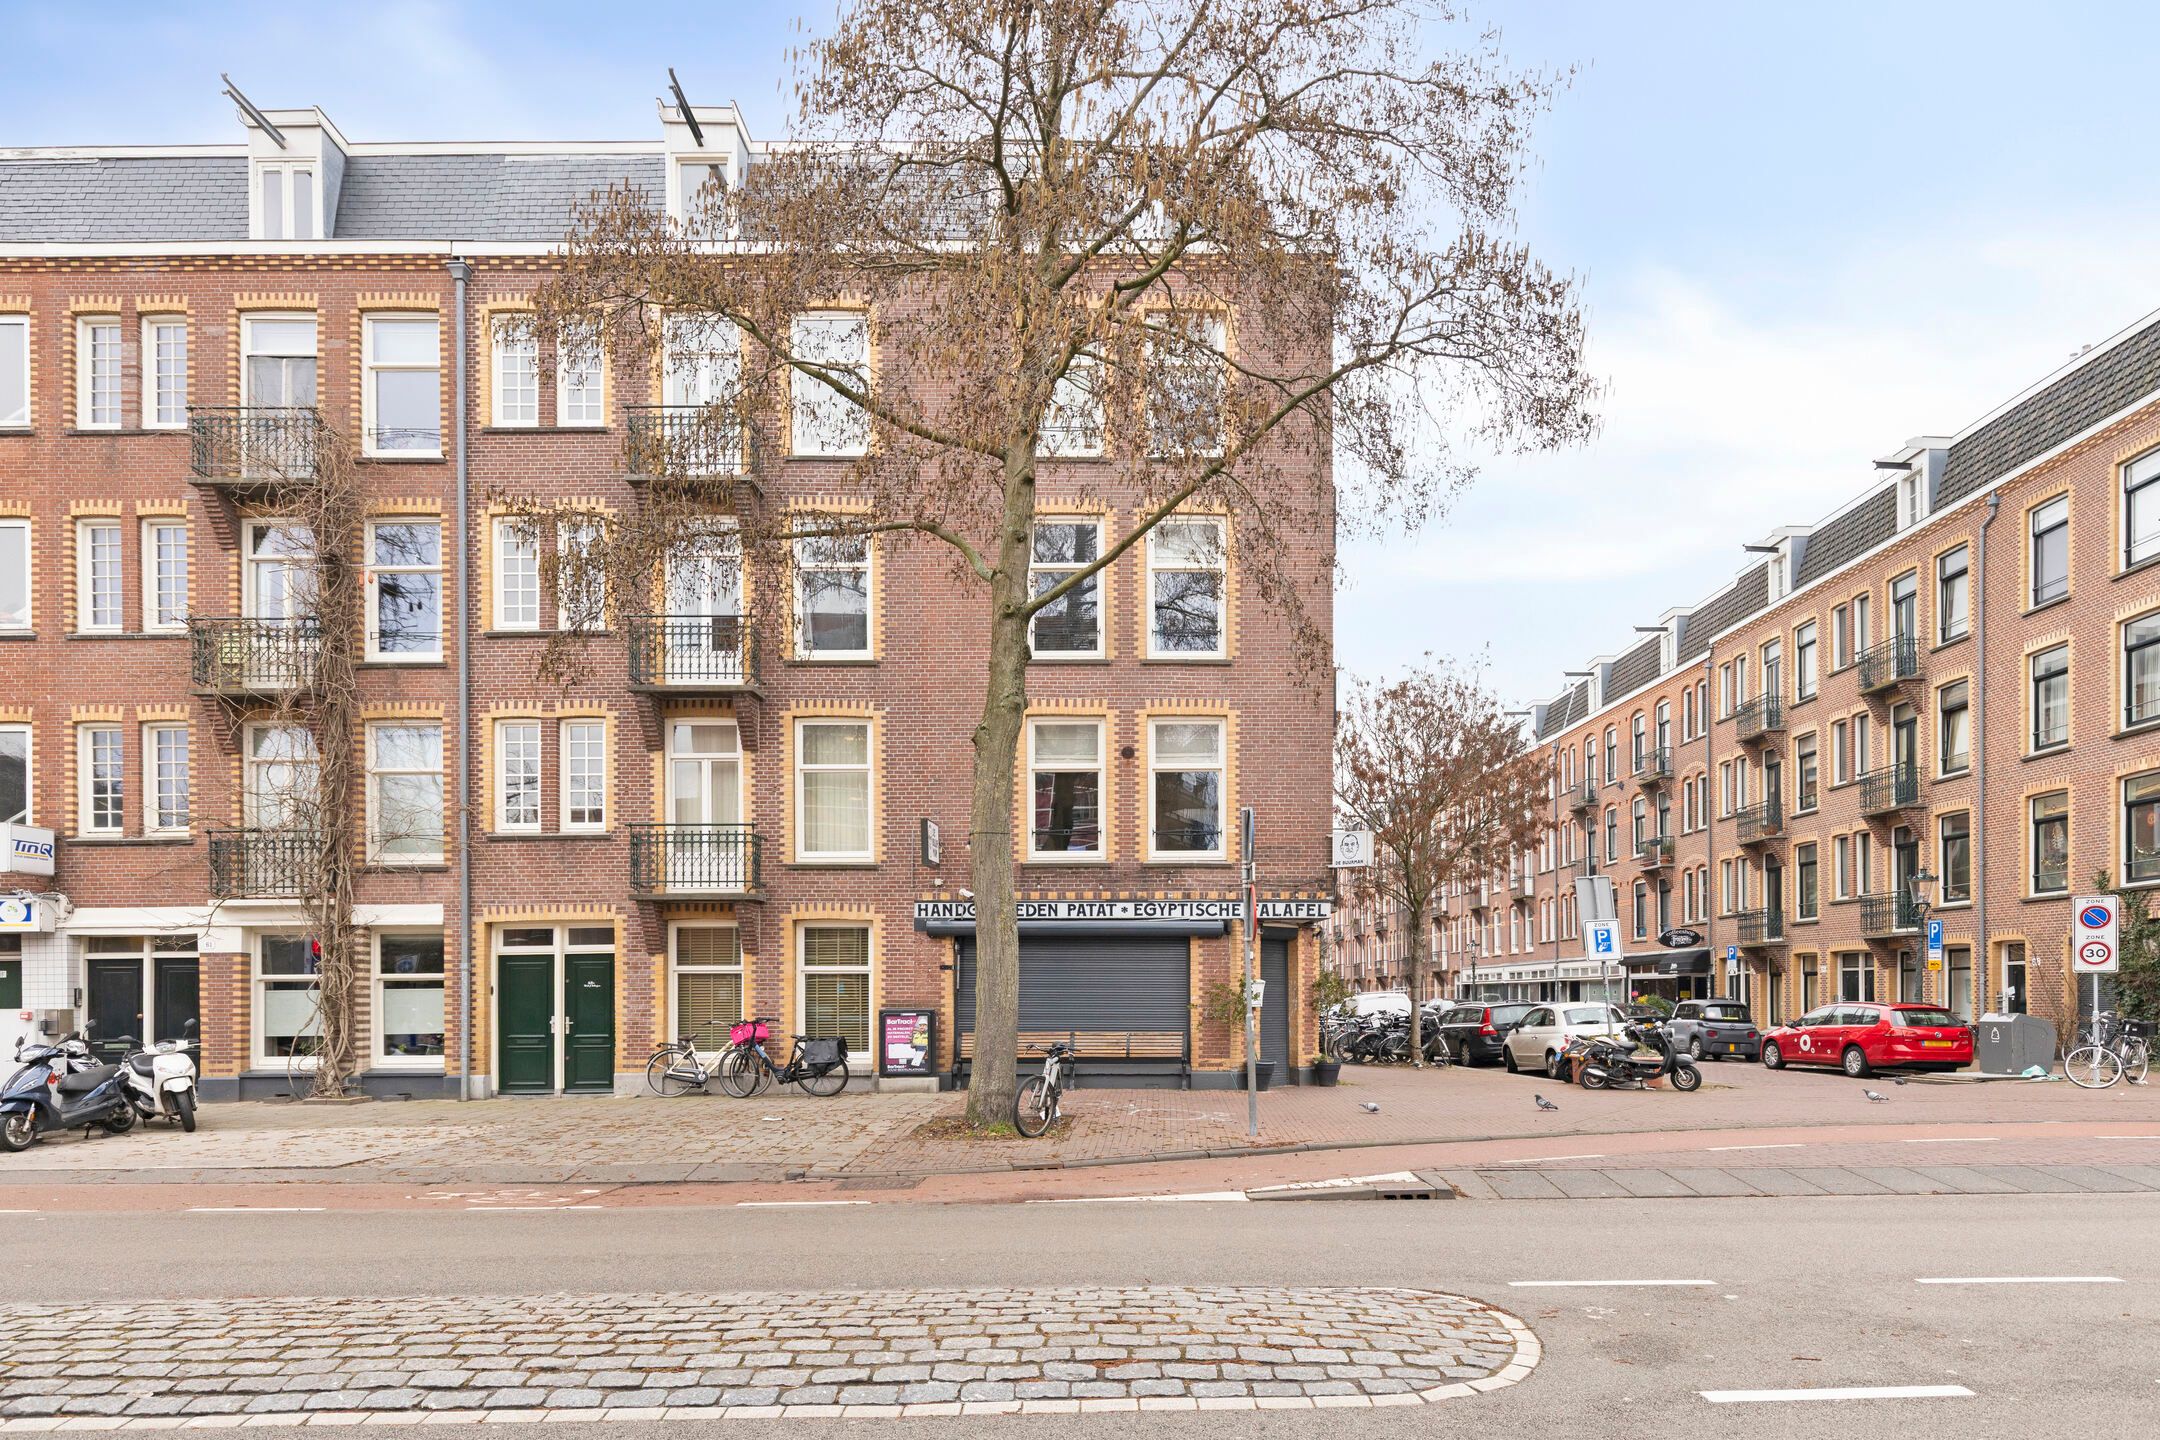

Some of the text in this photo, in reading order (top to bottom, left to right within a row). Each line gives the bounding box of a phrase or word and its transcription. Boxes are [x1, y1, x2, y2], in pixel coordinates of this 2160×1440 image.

[1067, 903, 1117, 917] PATAT
[1133, 903, 1241, 917] EGYPTISCHE
[1255, 903, 1327, 917] ALAFEL
[1597, 930, 1608, 943] P
[1931, 923, 1939, 939] P
[2085, 948, 2106, 958] 30
